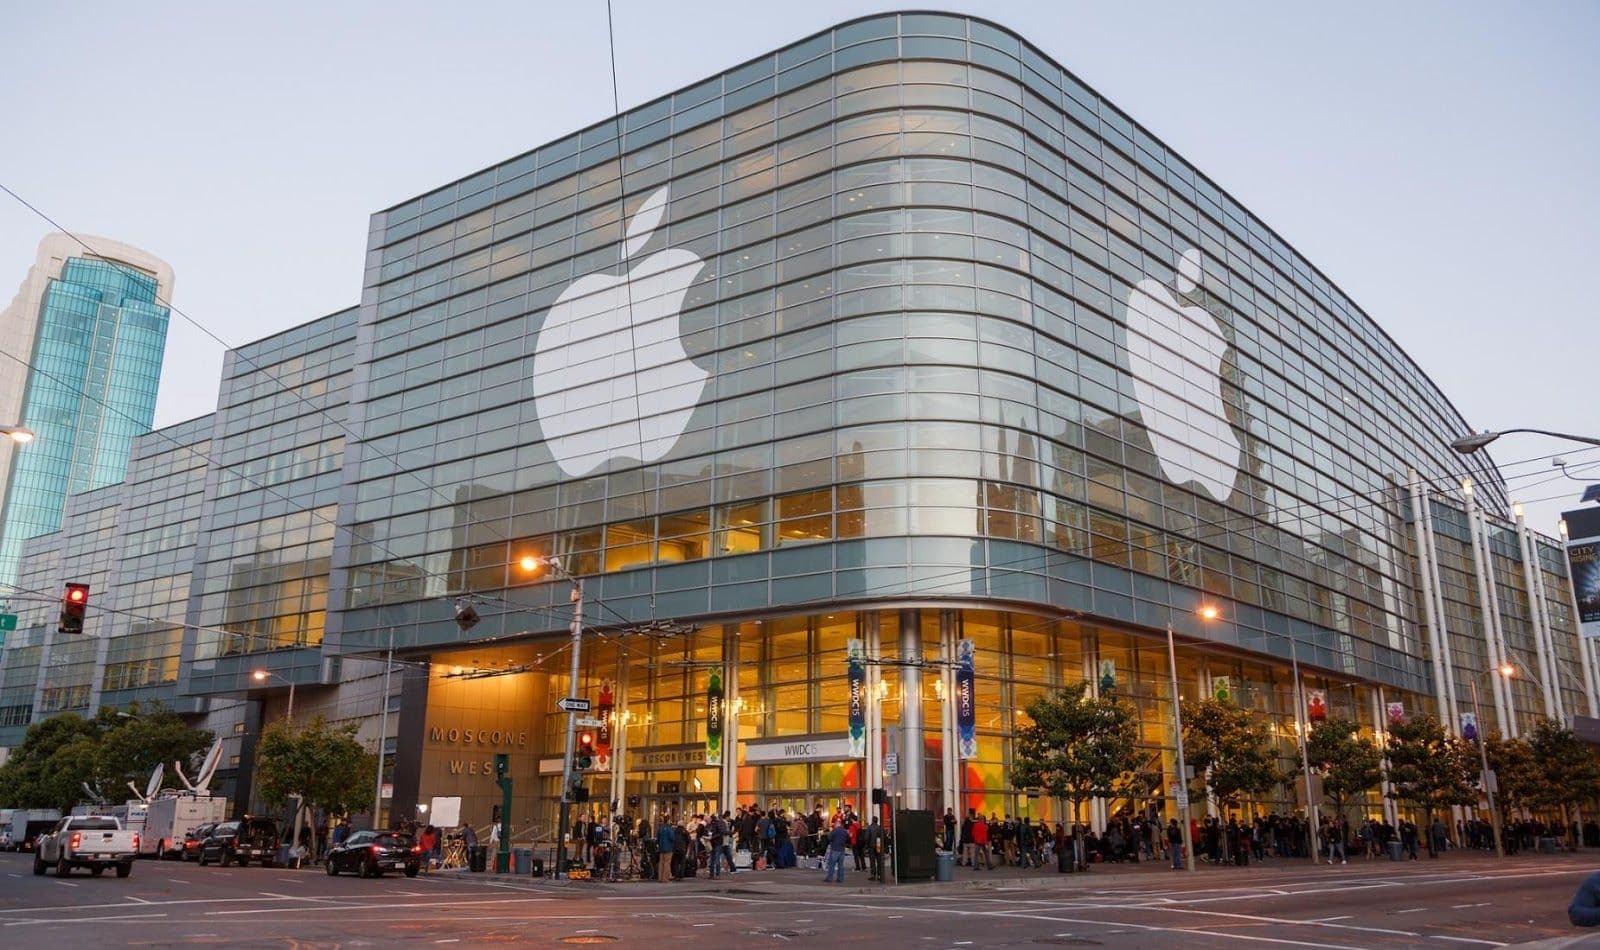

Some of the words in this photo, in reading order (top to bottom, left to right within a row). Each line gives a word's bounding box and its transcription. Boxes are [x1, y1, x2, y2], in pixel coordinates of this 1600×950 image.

[1570, 545, 1594, 555] CITY
[852, 679, 860, 716] WWDC15
[962, 679, 970, 717] WWDC15
[431, 726, 528, 745] MOSCONE
[449, 760, 493, 776] WES
